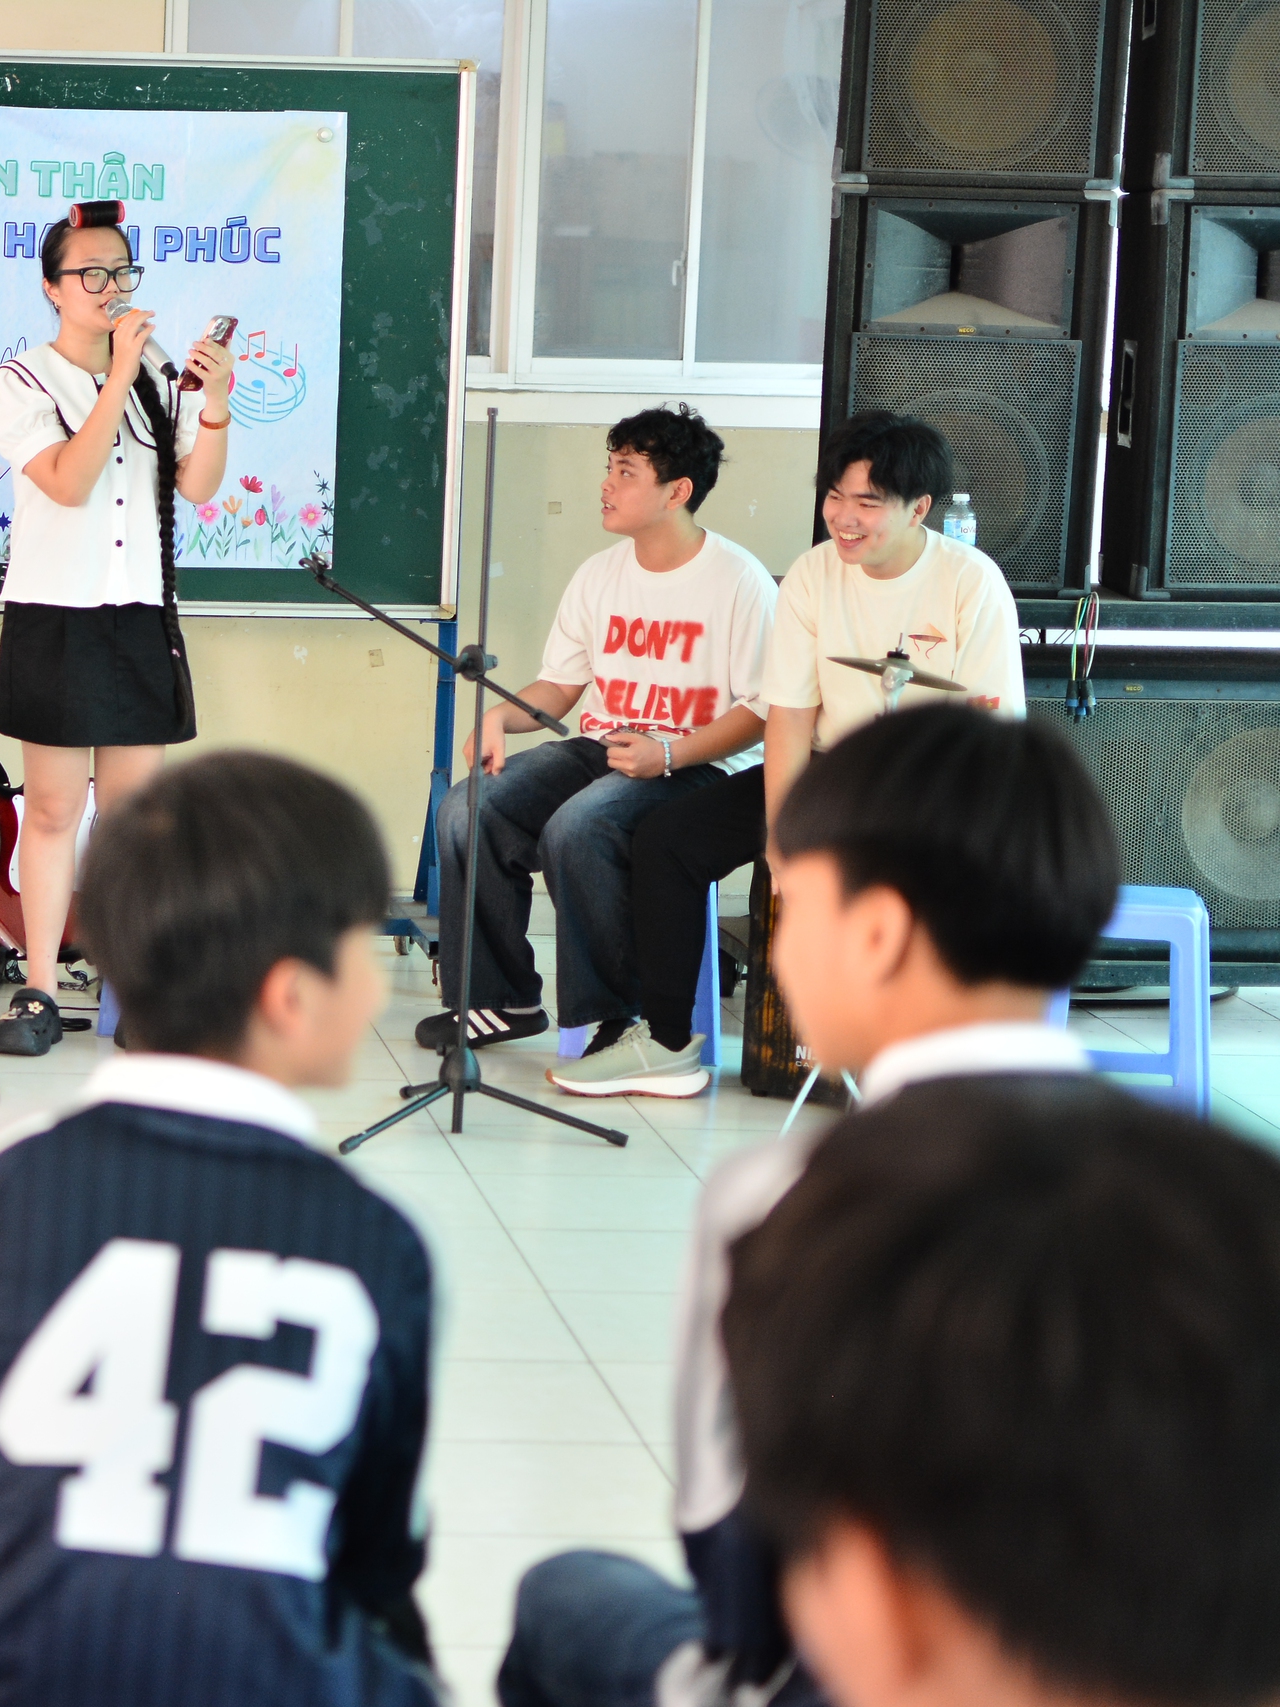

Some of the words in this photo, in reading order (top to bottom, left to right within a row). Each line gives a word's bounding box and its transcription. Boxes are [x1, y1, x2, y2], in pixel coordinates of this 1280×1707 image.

[30, 152, 165, 200] THÂN
[153, 215, 282, 264] PHÚC
[603, 614, 704, 663] DON'T
